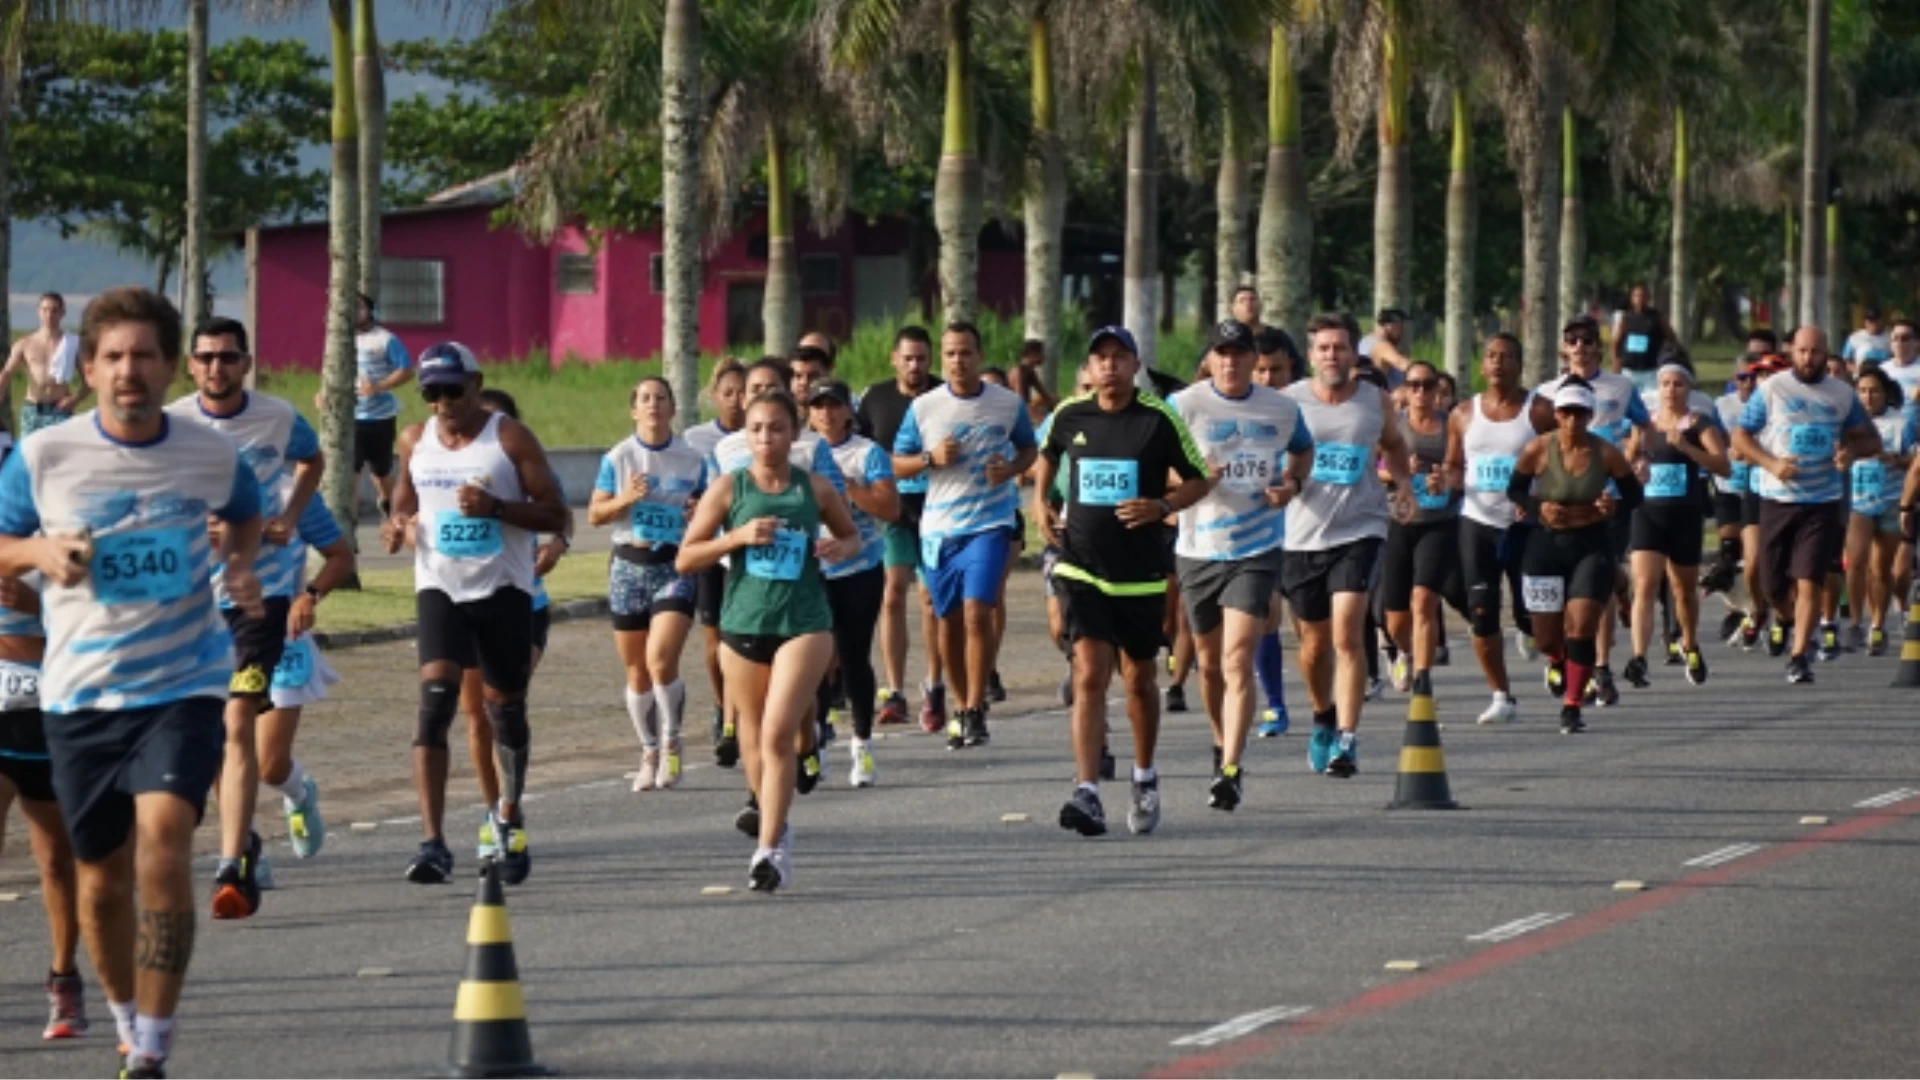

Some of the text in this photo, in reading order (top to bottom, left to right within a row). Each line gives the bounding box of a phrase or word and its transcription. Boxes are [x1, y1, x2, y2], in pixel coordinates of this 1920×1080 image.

[1082, 473, 1129, 491] 5645
[440, 522, 491, 542] 5222
[101, 547, 177, 581] 5340
